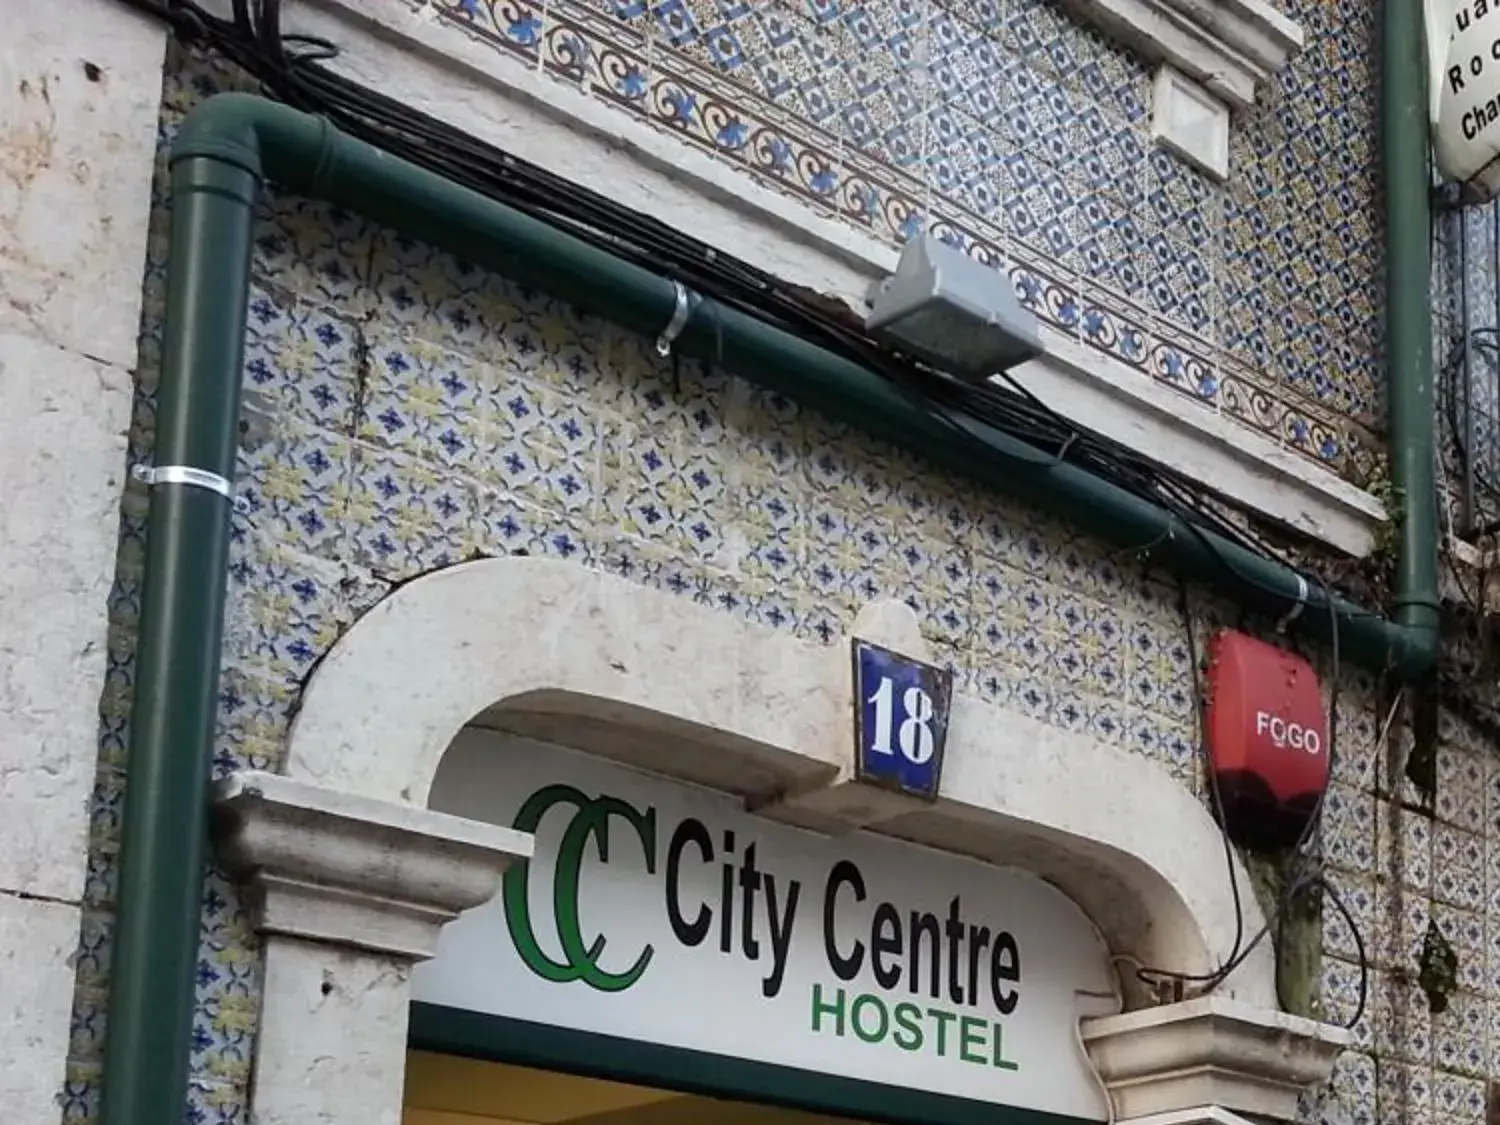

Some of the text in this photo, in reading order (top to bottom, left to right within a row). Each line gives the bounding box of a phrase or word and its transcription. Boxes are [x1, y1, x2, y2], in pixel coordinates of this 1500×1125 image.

[866, 675, 936, 765] 18
[1257, 711, 1321, 755] FOGO
[665, 817, 800, 998] City
[822, 860, 1021, 1016] Centre
[811, 983, 1020, 1071] HOSTEL
